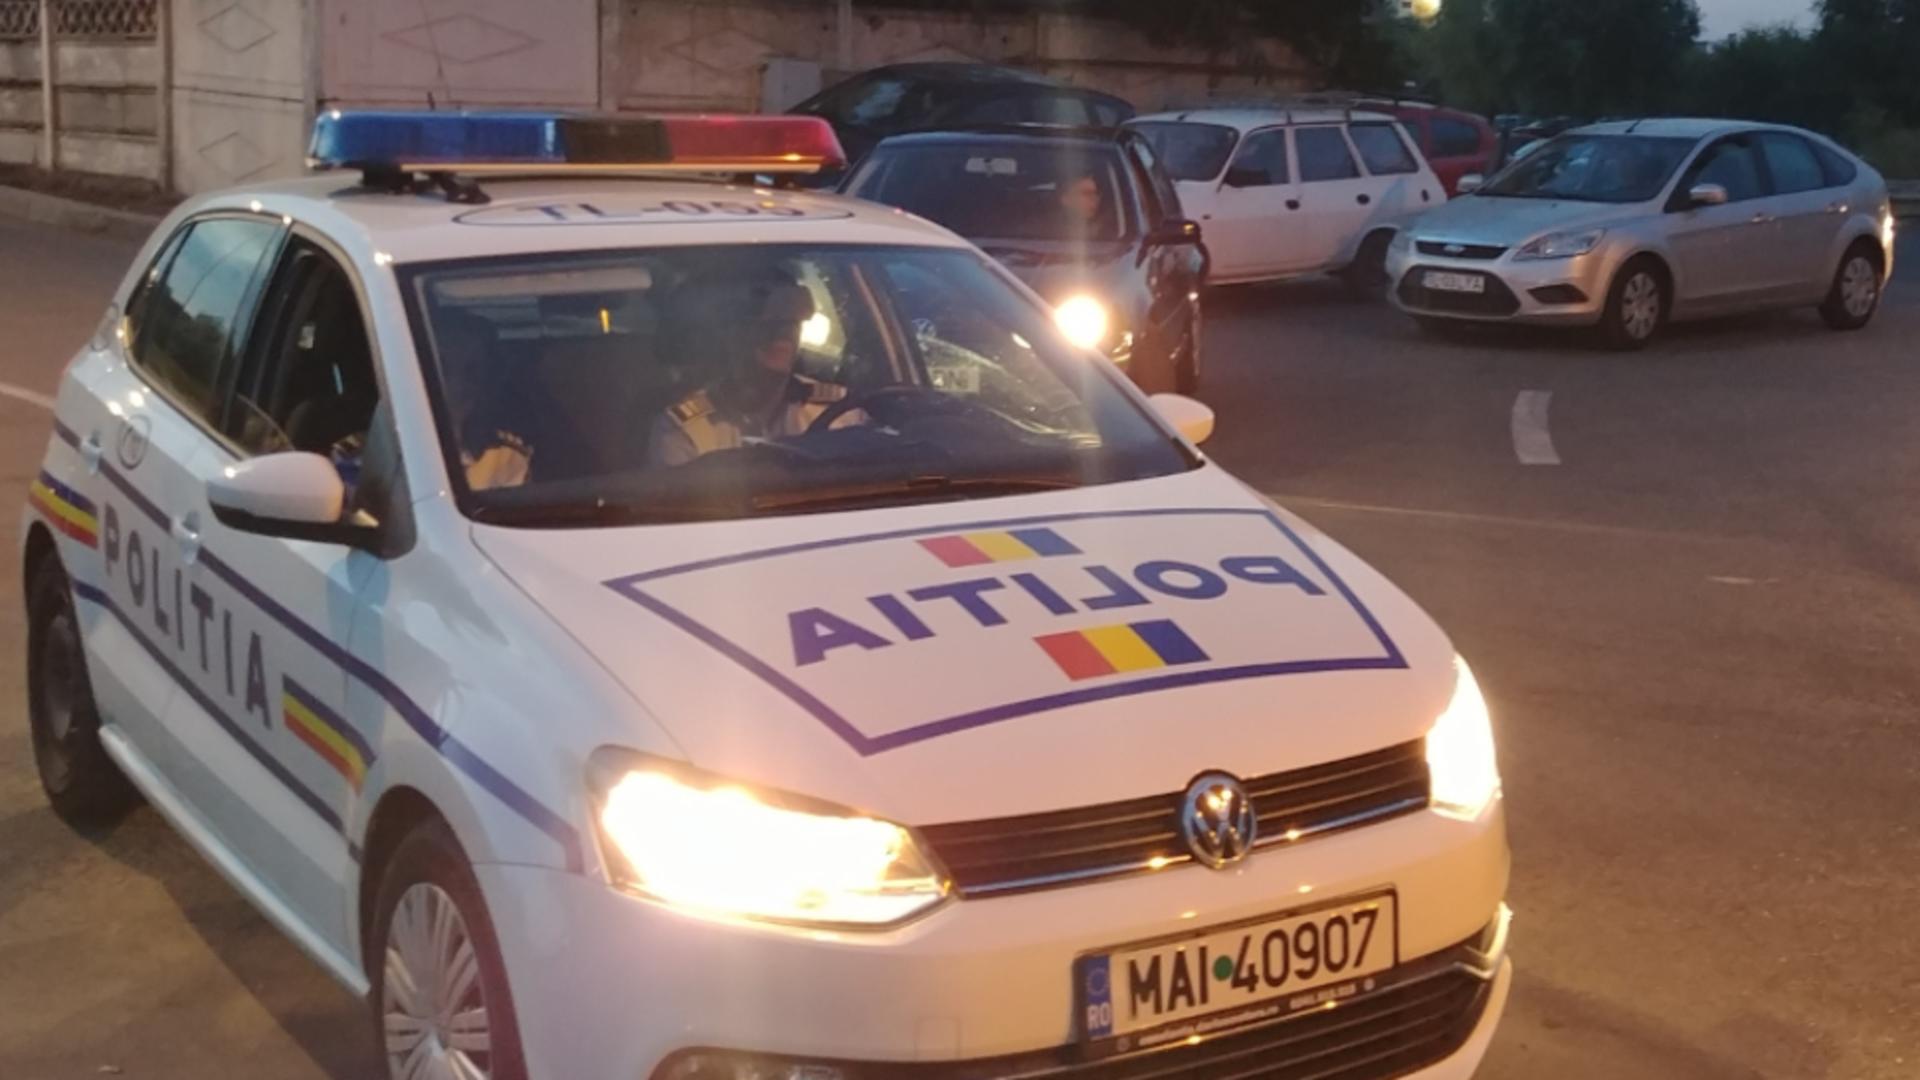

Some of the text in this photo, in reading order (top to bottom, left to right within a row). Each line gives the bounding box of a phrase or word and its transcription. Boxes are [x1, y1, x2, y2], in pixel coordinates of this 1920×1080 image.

[104, 502, 272, 730] POLITIA
[1087, 1002, 1111, 1031] RO
[1128, 908, 1379, 1020] MAI 40907
